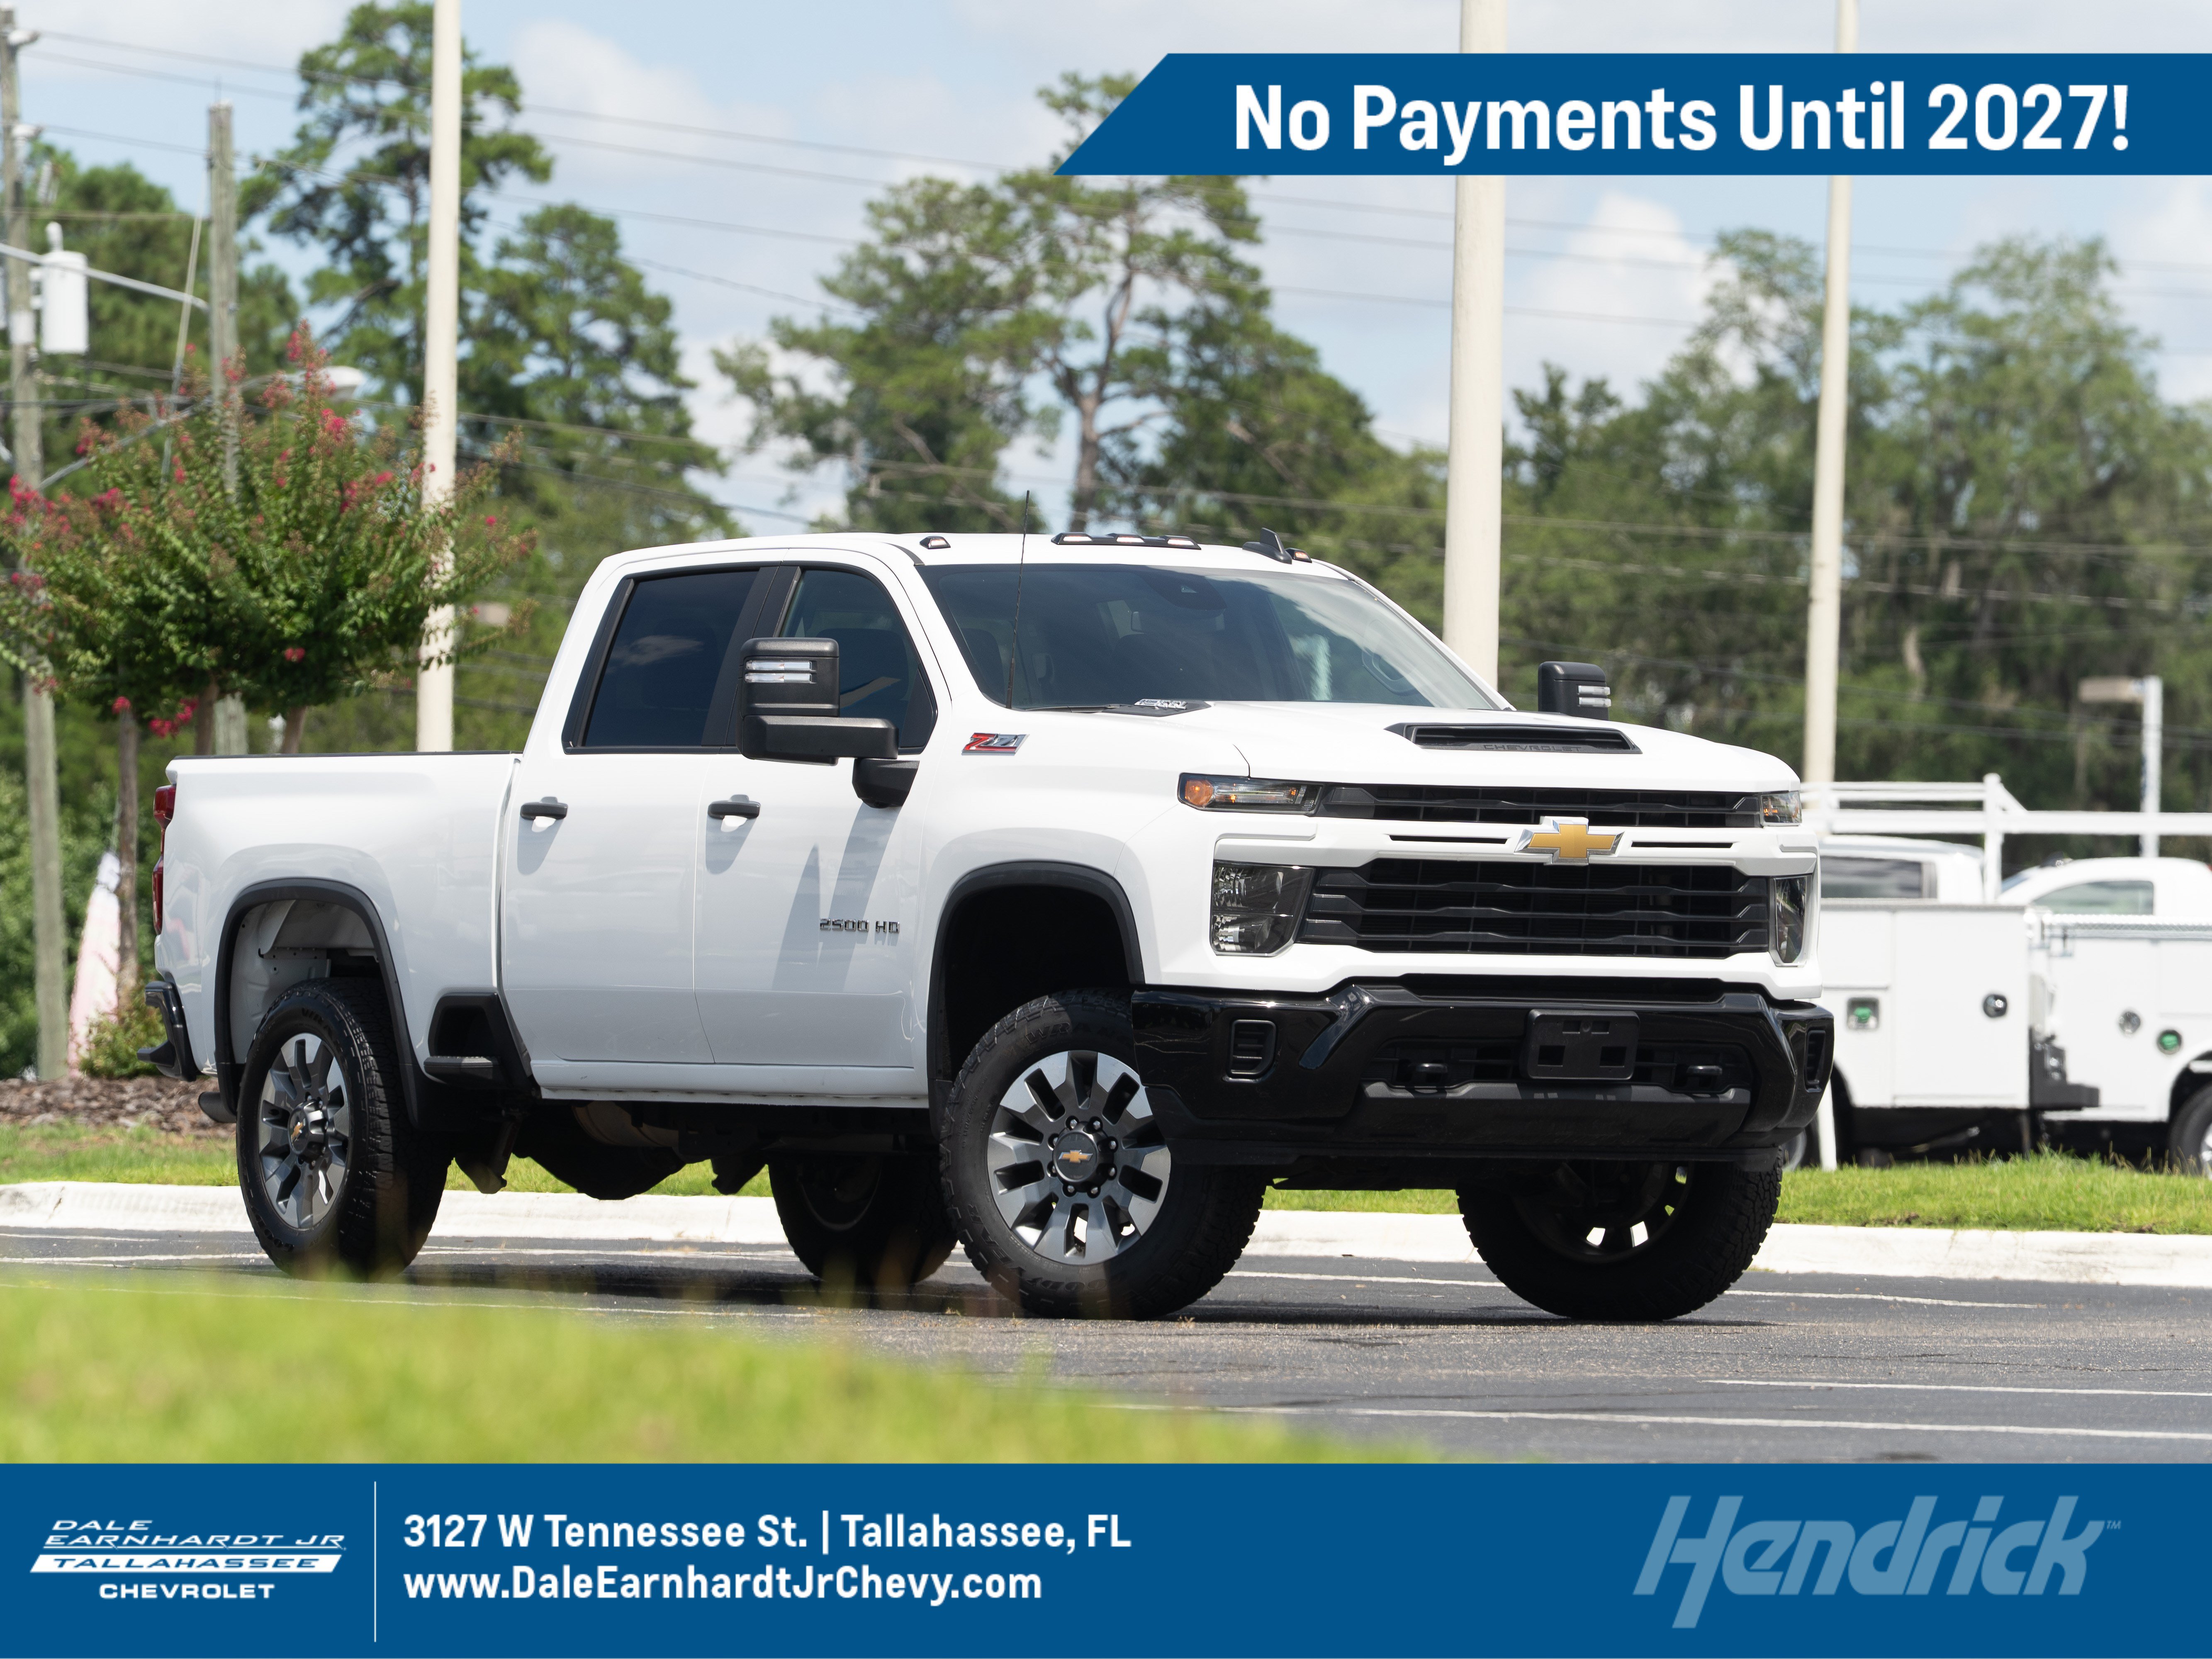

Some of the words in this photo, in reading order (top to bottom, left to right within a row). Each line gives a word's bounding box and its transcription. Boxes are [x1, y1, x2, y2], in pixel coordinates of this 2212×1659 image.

[961, 732, 1029, 754] Z71
[1483, 744, 1582, 752] CHEVROLET
[820, 918, 869, 932] 2500
[875, 920, 900, 933] HD
